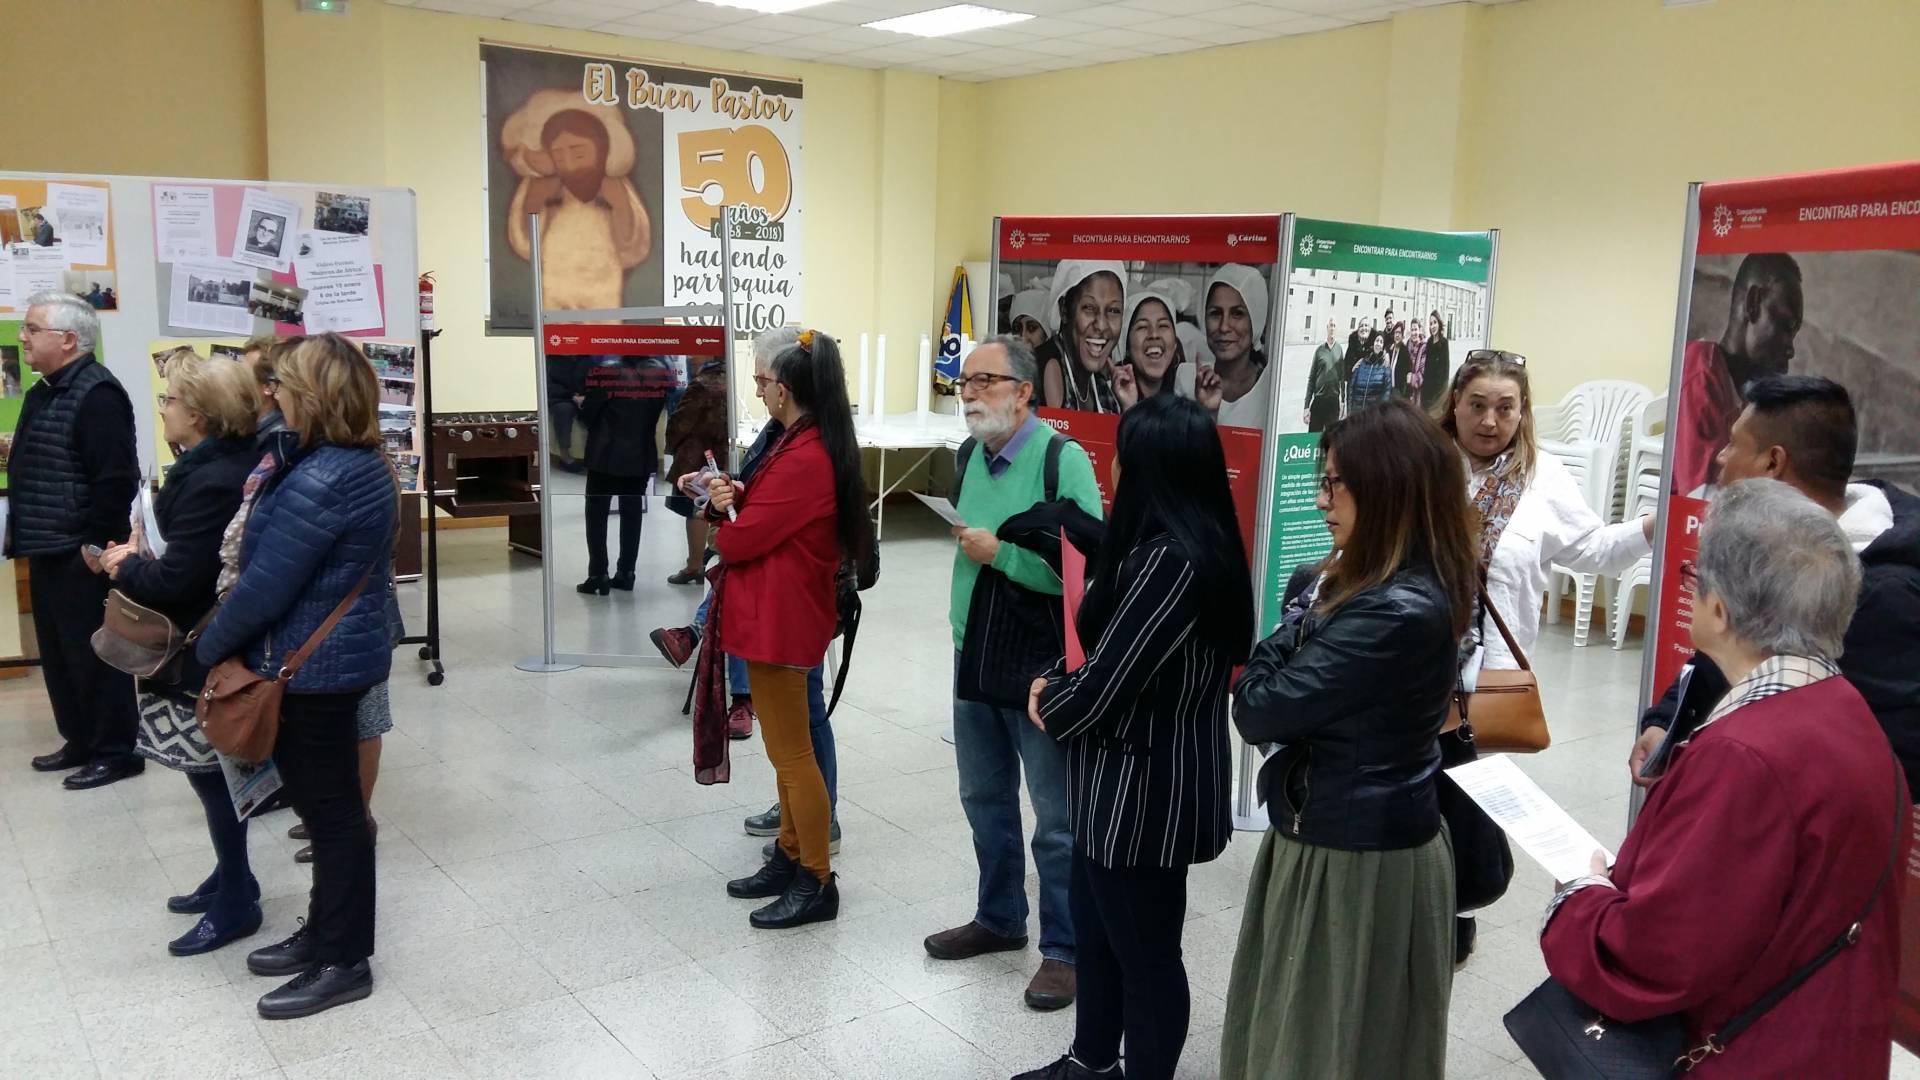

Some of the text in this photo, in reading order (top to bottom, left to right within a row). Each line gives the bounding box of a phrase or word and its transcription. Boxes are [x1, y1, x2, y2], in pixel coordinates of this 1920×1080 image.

[584, 64, 793, 121] El Buen Pastor
[677, 125, 793, 231] 50
[1800, 205, 1858, 221] ENCONTRAR
[1860, 203, 1888, 217] PARA
[755, 227, 783, 241] 2018)
[1073, 234, 1191, 244] ENCONTRAR PARA ENCONTRARNOS
[1238, 233, 1268, 242] Cáritas
[680, 241, 787, 271] hacendo
[1353, 245, 1438, 261] ENCONTRAR PARA ENCONTRARNOS
[1283, 444, 1312, 463] ¿Qué
